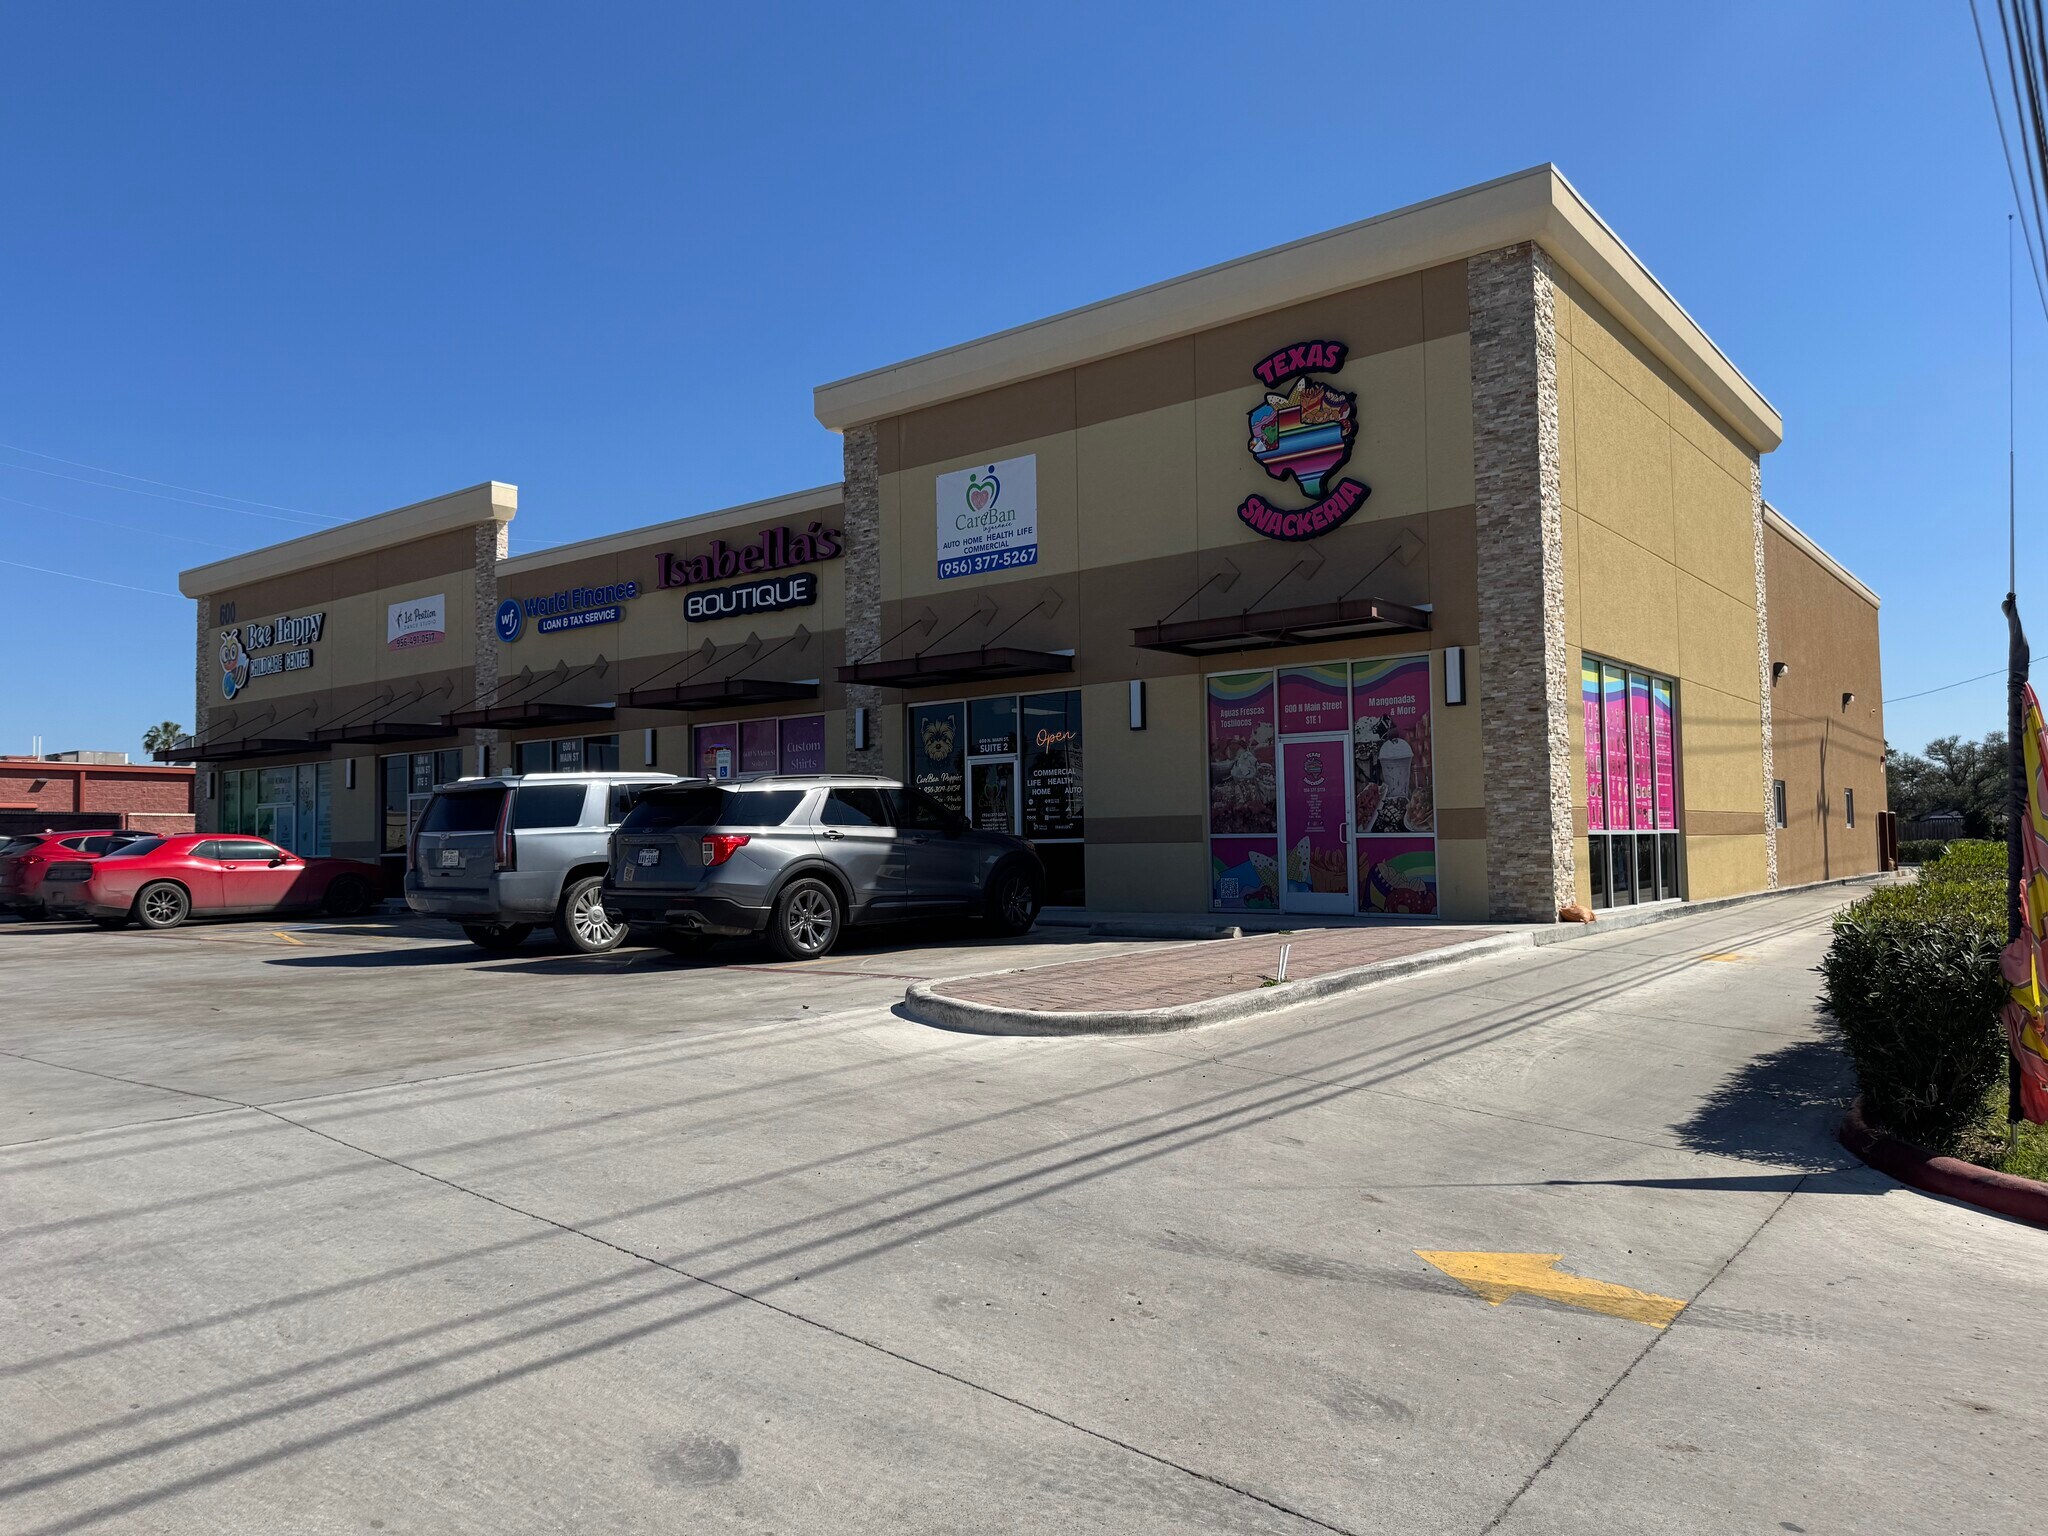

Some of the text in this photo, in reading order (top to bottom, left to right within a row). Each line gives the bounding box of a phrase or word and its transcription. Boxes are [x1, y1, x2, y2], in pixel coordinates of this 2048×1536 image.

[1257, 344, 1340, 384] TEXAS
[1241, 481, 1363, 537] SNACKERIA
[955, 508, 1016, 531] CareBan
[943, 526, 1033, 550] AUTO HOME HEALTH LIFE
[963, 540, 1010, 555] COMMERCIAL
[655, 521, 842, 590] Isabella's
[940, 547, 1036, 579] (956) 377-5267
[523, 580, 637, 619] World Finance
[687, 578, 808, 617] BOUTIQUE
[220, 601, 236, 625] 600
[542, 608, 616, 631] LOAN & TAX SERVICE
[246, 612, 324, 651] Bee Happy
[250, 649, 311, 677] CHILDCARE CENTER
[1284, 700, 1342, 714] 600 N Main Street
[1368, 694, 1416, 707] Mangonadas
[1220, 706, 1265, 718] Aguas Frescas
[1390, 706, 1416, 716] & More
[1305, 714, 1321, 725] STE 1
[562, 742, 571, 752] 600
[787, 741, 821, 754] Custom
[980, 742, 1009, 753] SUITE 2
[1036, 728, 1076, 755] Open
[572, 752, 580, 762] ST
[791, 757, 817, 771] Shirts
[1033, 767, 1076, 778] COMMERCIAL
[1027, 777, 1073, 787] LIFE HEALTH
[1032, 786, 1083, 797] HOME AUTO
